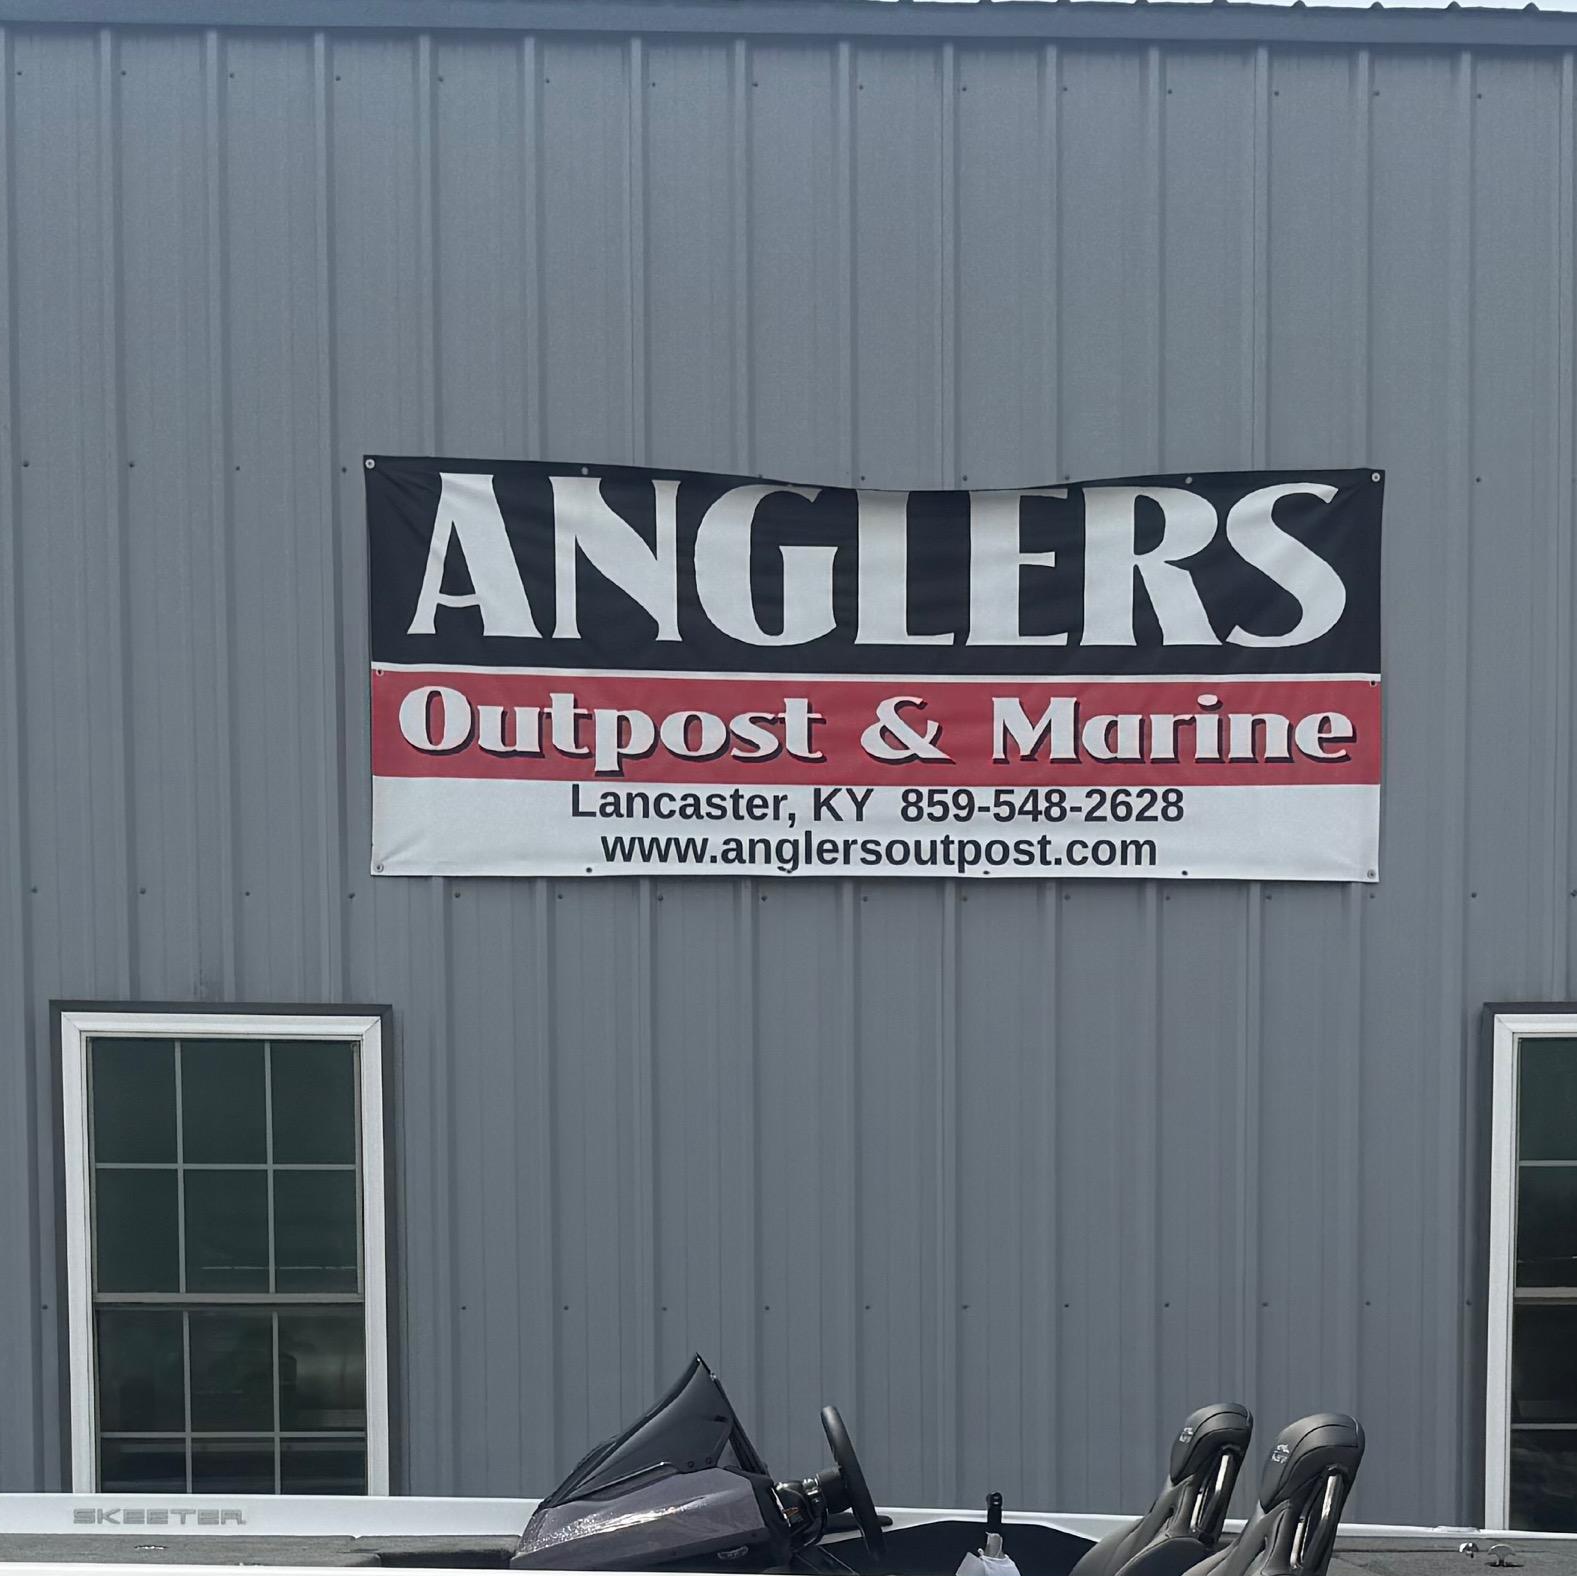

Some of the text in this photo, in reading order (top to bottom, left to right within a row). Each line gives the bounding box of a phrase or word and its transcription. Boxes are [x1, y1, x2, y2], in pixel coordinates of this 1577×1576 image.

[407, 472, 1346, 648] ANGLERS
[399, 685, 1355, 777] Outpost & Marine
[571, 782, 1184, 828] Lancaster, KY 859-548-2628
[601, 829, 1158, 873] www.anglersoutpost.com
[73, 1508, 246, 1525] SKEETER
